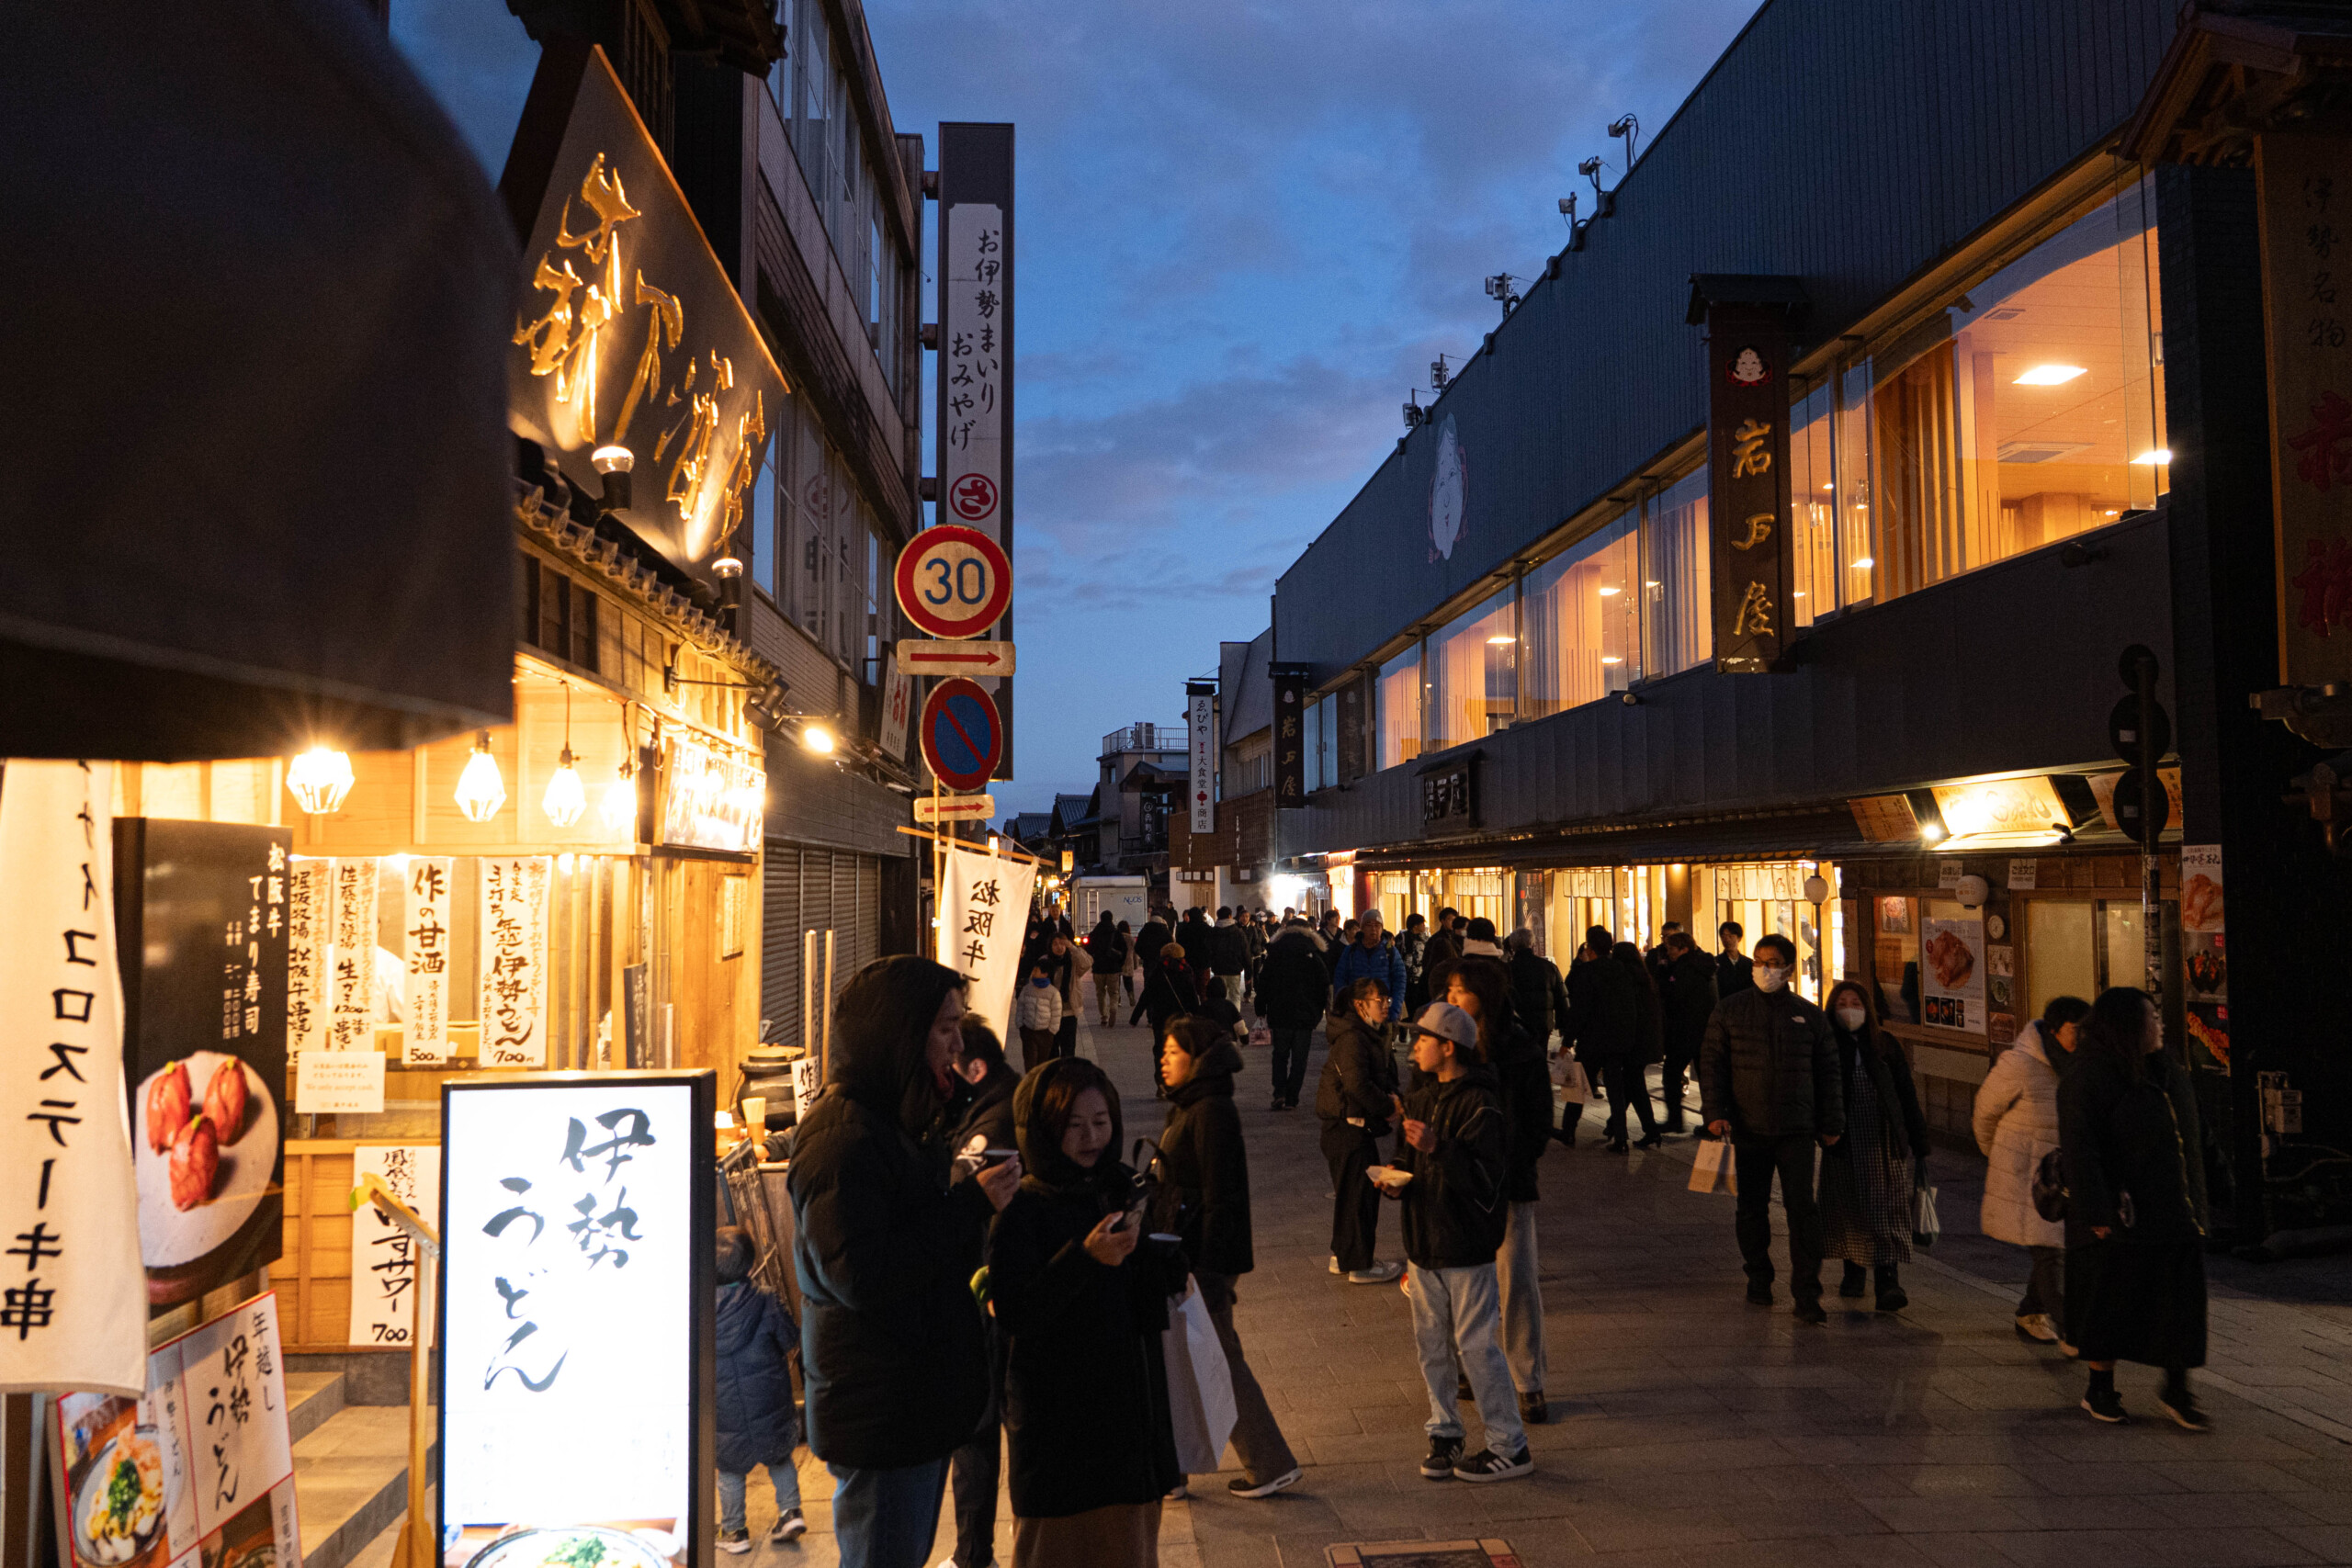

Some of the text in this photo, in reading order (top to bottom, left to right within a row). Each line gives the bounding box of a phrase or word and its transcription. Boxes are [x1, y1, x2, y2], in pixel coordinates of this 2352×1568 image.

[975, 229, 1000, 414] お伊勢まいり
[949, 333, 975, 452] おみやげ
[925, 558, 986, 605] 30
[1731, 418, 1775, 637] 岩戸屋
[1197, 757, 1207, 788] 大食堂
[1197, 808, 1207, 830] 商店
[267, 841, 285, 938] 松阪牛
[409, 863, 446, 975] 作の甘酒
[244, 875, 264, 1034] てまり寿司
[560, 1108, 656, 1270] 伊勢
[482, 1177, 569, 1393] うどん
[207, 1387, 239, 1511] うどん
